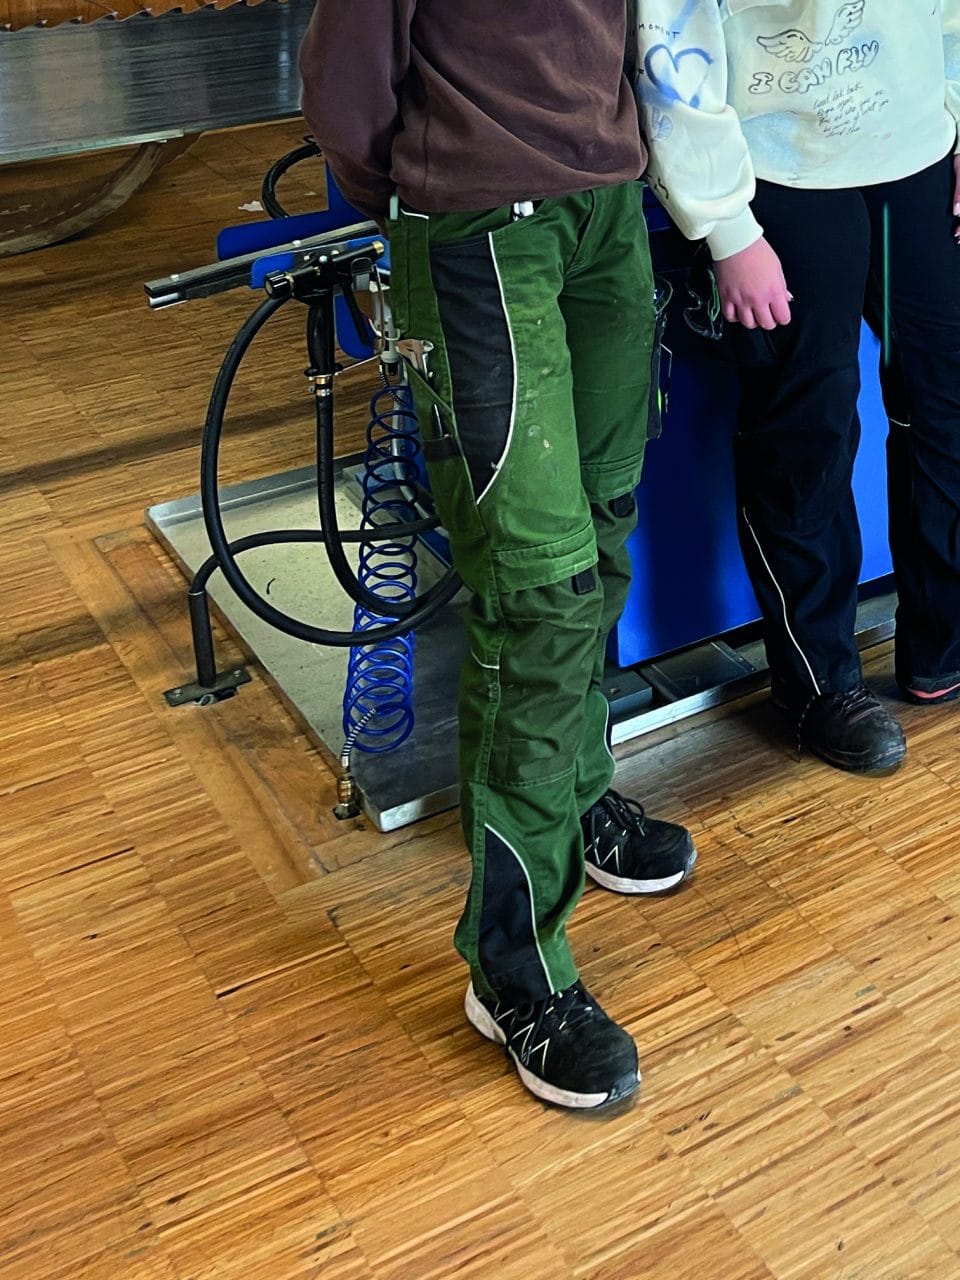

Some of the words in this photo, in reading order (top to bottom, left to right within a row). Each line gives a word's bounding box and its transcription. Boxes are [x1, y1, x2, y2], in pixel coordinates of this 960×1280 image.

[748, 71, 774, 95] I
[778, 58, 832, 94] CAN
[836, 40, 879, 75] FLY
